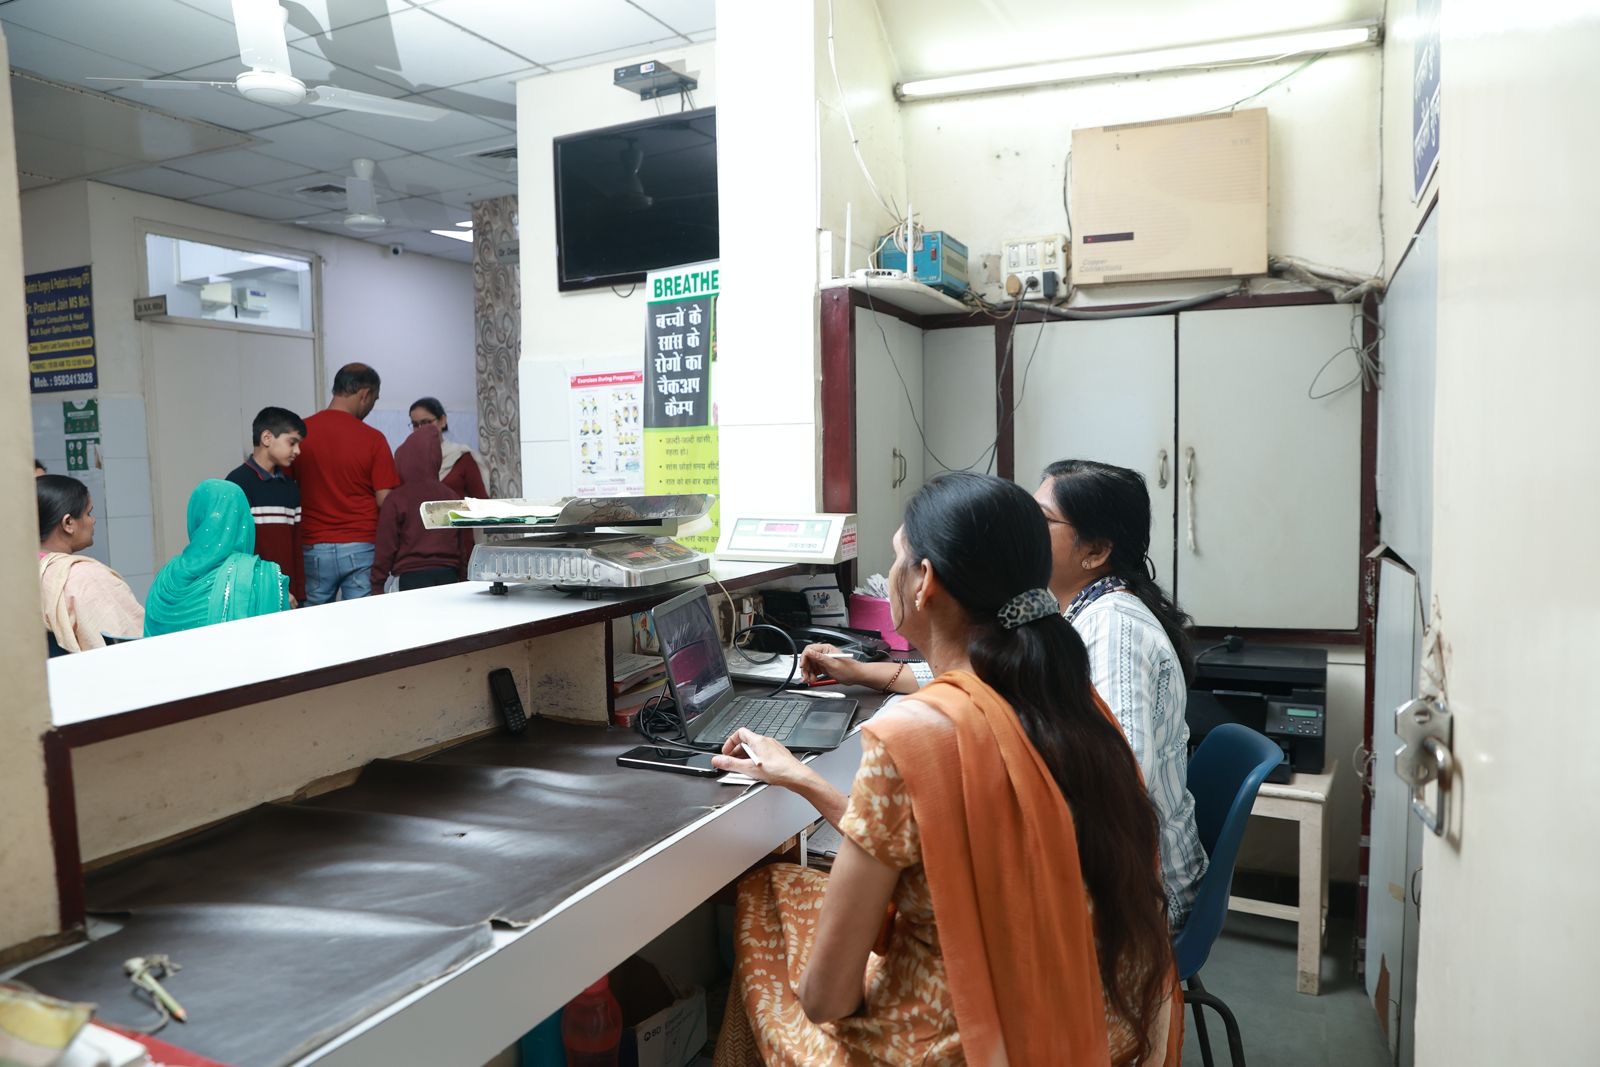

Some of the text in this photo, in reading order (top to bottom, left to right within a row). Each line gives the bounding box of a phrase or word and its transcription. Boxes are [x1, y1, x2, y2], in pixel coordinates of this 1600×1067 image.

[654, 269, 719, 298] BREATHE
[655, 303, 703, 329] बच्चों के
[657, 326, 701, 351] सांस के
[654, 351, 703, 373] रोगों का
[656, 374, 701, 395] चैकअप
[664, 396, 694, 417] कैम्प
